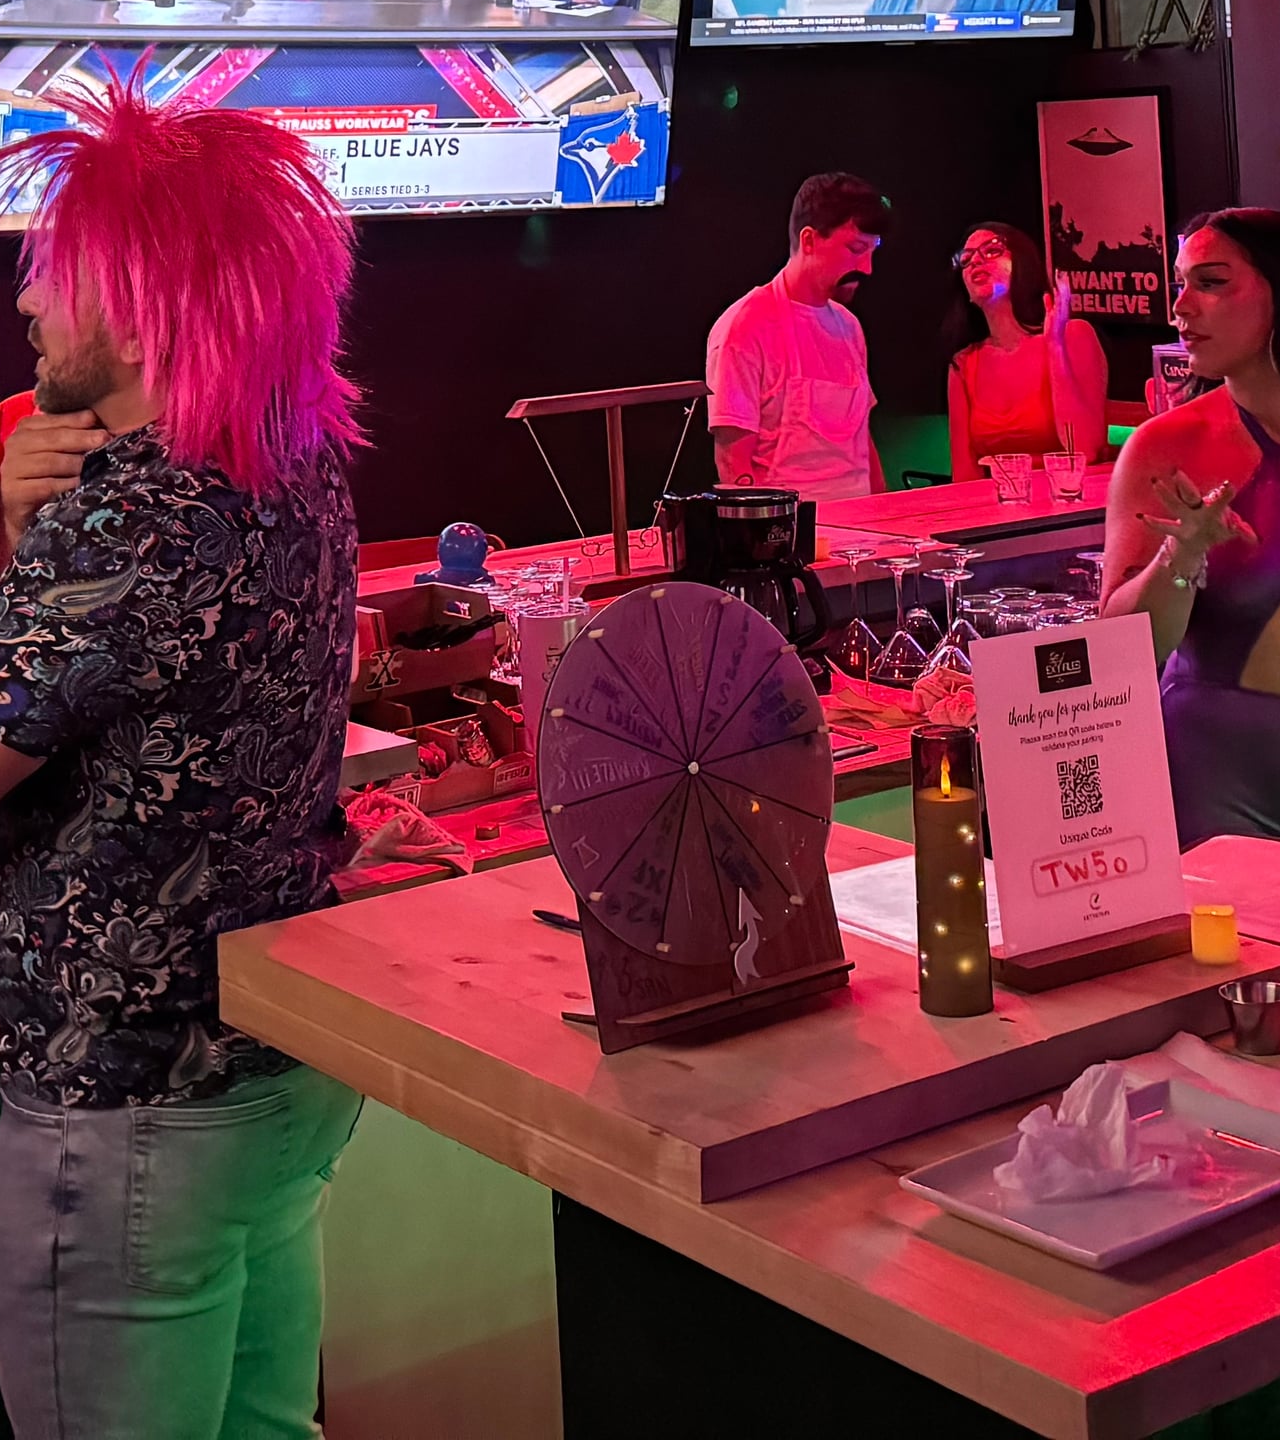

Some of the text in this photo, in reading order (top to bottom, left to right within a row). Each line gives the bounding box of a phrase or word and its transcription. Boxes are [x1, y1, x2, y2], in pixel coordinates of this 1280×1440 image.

[335, 117, 405, 130] WORKWEAR
[346, 139, 402, 158] BLUE
[406, 138, 460, 157] JAYS
[351, 185, 388, 196] SERIES
[390, 185, 412, 195] TIED
[414, 184, 430, 194] 3-3
[1070, 271, 1159, 292] WANT TO
[1070, 294, 1151, 315] BELIEVE
[1009, 685, 1131, 729] thank you for your business!
[1090, 825, 1113, 837] Code
